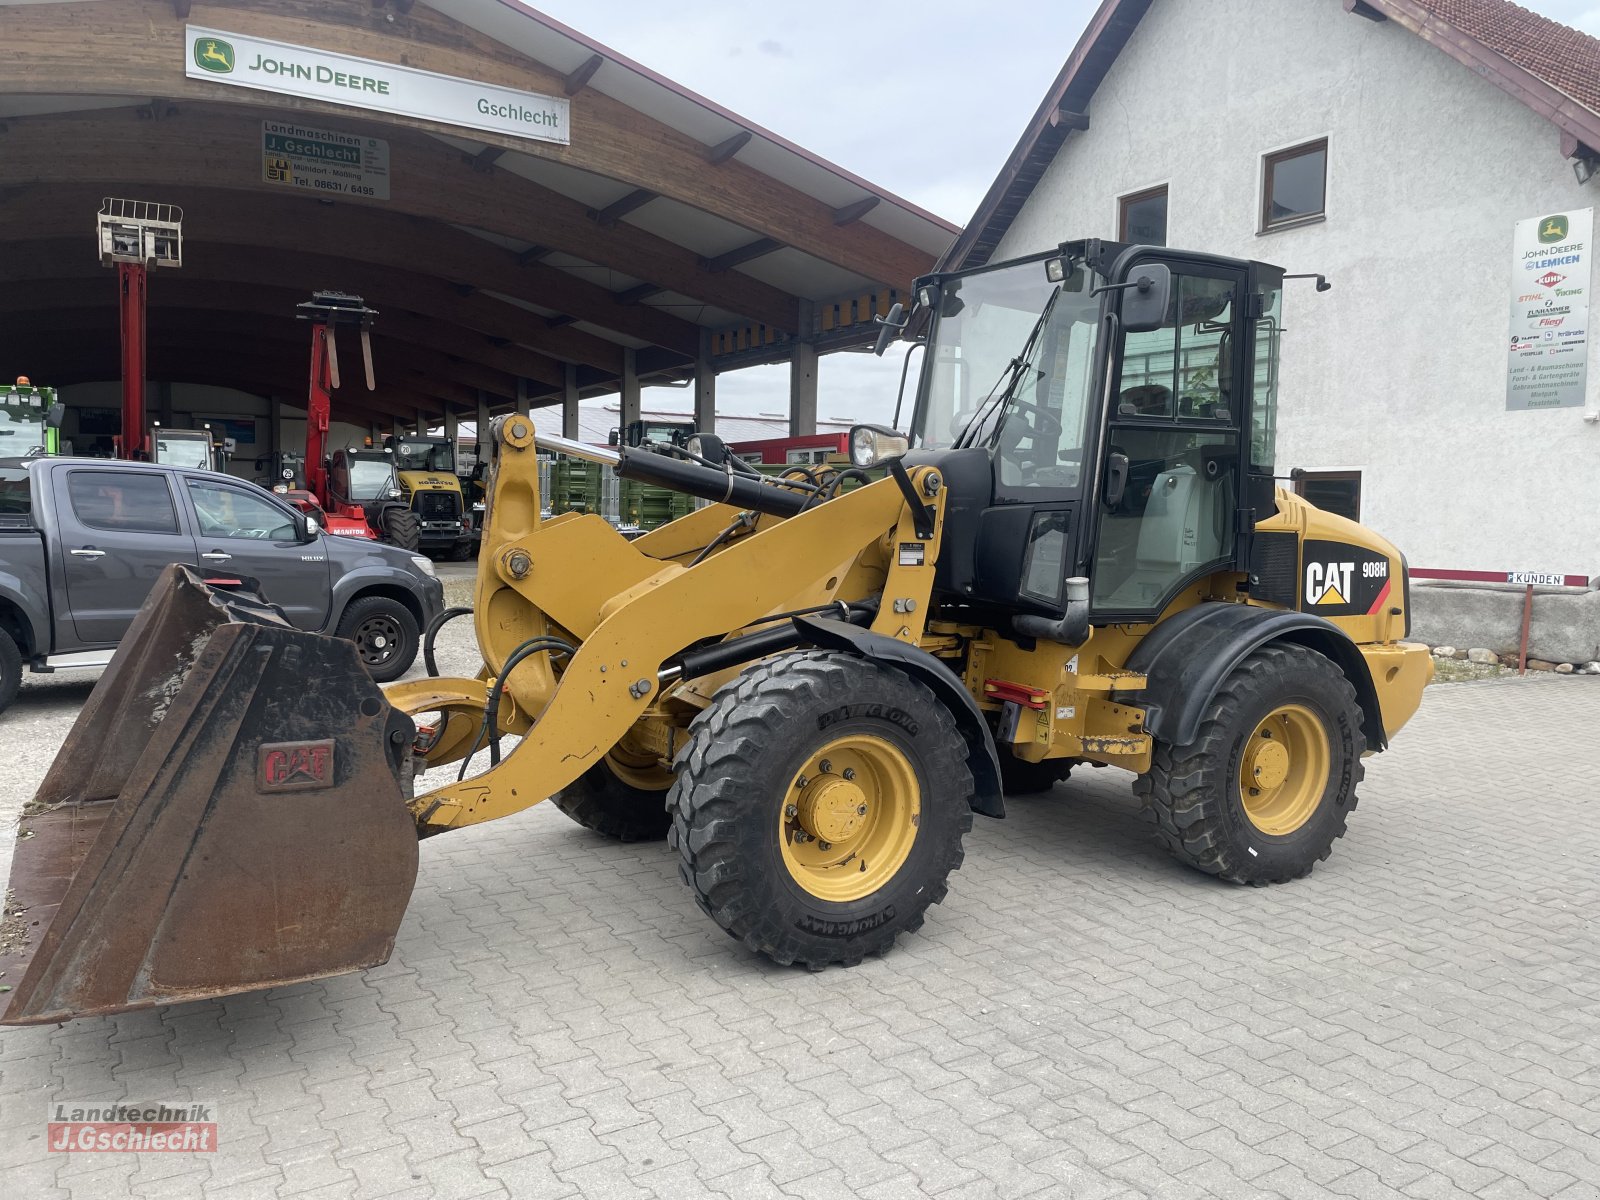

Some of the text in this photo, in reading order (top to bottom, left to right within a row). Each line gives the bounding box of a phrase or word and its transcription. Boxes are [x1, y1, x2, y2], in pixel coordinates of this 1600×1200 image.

[248, 54, 390, 95] JOHN DEERE
[476, 98, 559, 128] Gschlecht
[264, 122, 361, 145] Landmaschinen
[268, 137, 358, 161] J. Gschlecht
[293, 176, 312, 187] Tel.
[314, 179, 342, 191] 08631
[351, 185, 374, 196] 6495
[1522, 243, 1583, 259] JOHN DEERE
[1535, 255, 1580, 269] LEMKEN
[1538, 275, 1563, 284] KUHN
[1518, 293, 1543, 303] STIHL
[1554, 288, 1583, 297] VIKING
[1539, 317, 1565, 327] Fliegl
[1537, 362, 1584, 372] Baumaschinen
[1512, 380, 1579, 391] Gebrauchtmaschinen
[284, 469, 292, 477] 25
[1305, 561, 1388, 605] CAT 908H
[1516, 573, 1561, 585] KUNDEN
[265, 747, 330, 786] CAT
